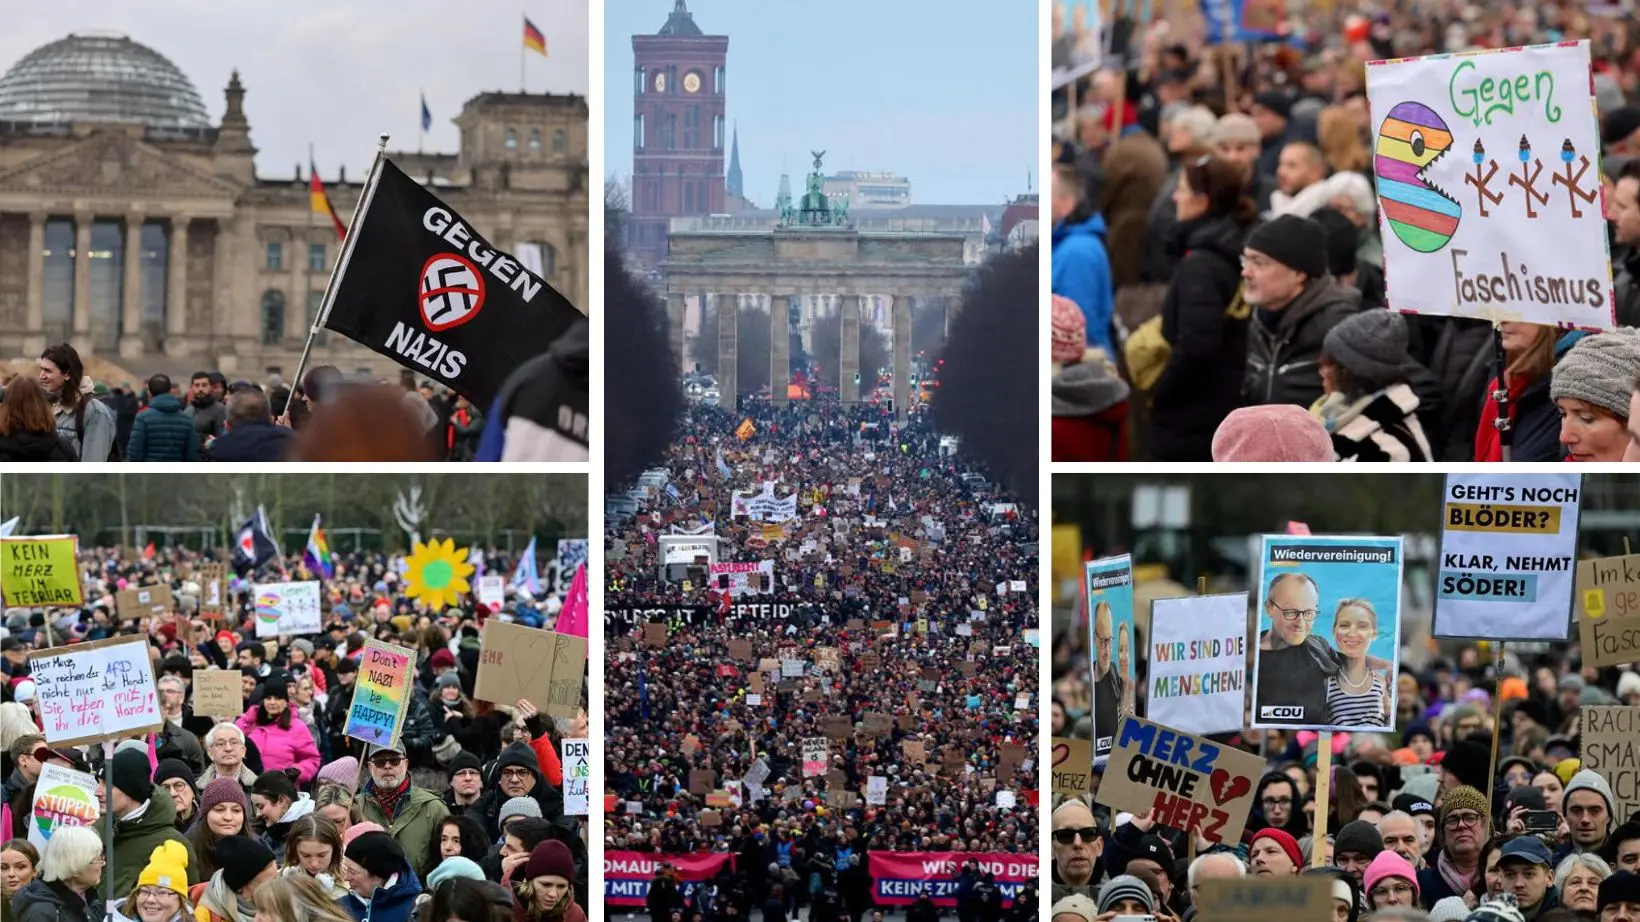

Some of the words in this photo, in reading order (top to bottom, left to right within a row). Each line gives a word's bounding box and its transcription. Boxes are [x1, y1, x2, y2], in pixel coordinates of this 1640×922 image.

[1449, 60, 1562, 128] Gegen
[422, 206, 543, 303] GEGEN
[1450, 248, 1605, 308] Faschismus
[384, 321, 467, 379] NAZIS
[1451, 484, 1515, 501] GEHT'S
[1522, 487, 1577, 502] NOCH
[1450, 504, 1550, 528] BLÖDER?
[11, 544, 49, 560] KEIN
[1274, 549, 1391, 563] Wiedervereinigung!
[1444, 554, 1499, 571] KLAR,
[1506, 556, 1571, 571] NEHMT
[13, 564, 53, 577] MERZ
[1593, 561, 1617, 585] Im
[1623, 558, 1640, 583] k
[31, 579, 46, 590] IM
[1443, 572, 1526, 596] SÖDER!
[1156, 642, 1185, 662] WIR
[1190, 639, 1221, 660] SIND
[1225, 636, 1243, 656] DIE
[32, 660, 50, 672] Herr
[36, 674, 51, 686] Sie
[87, 665, 99, 679] der
[106, 660, 132, 677] AfD
[42, 684, 70, 699] nicht
[76, 687, 94, 696] nur
[101, 676, 115, 691] die
[368, 670, 394, 687] NAZI
[1154, 670, 1242, 698] MENSCHEN!
[44, 702, 64, 715] Sie
[114, 689, 140, 702] mit
[369, 690, 382, 703] be
[56, 716, 68, 731] ihr
[77, 712, 99, 726] die
[352, 704, 395, 728] HAPPY!
[1272, 707, 1302, 717] CDU
[1118, 717, 1220, 775] MERZ
[1586, 741, 1640, 769] SMA
[1052, 771, 1087, 790] MERZ
[1127, 754, 1200, 799] OHNE
[40, 794, 93, 819] STOPPT
[1152, 791, 1229, 844] HERZ
[604, 859, 664, 874] MAUE
[1008, 864, 1036, 877] DIE
[611, 882, 643, 895] MIT
[881, 881, 932, 896] KEINE
